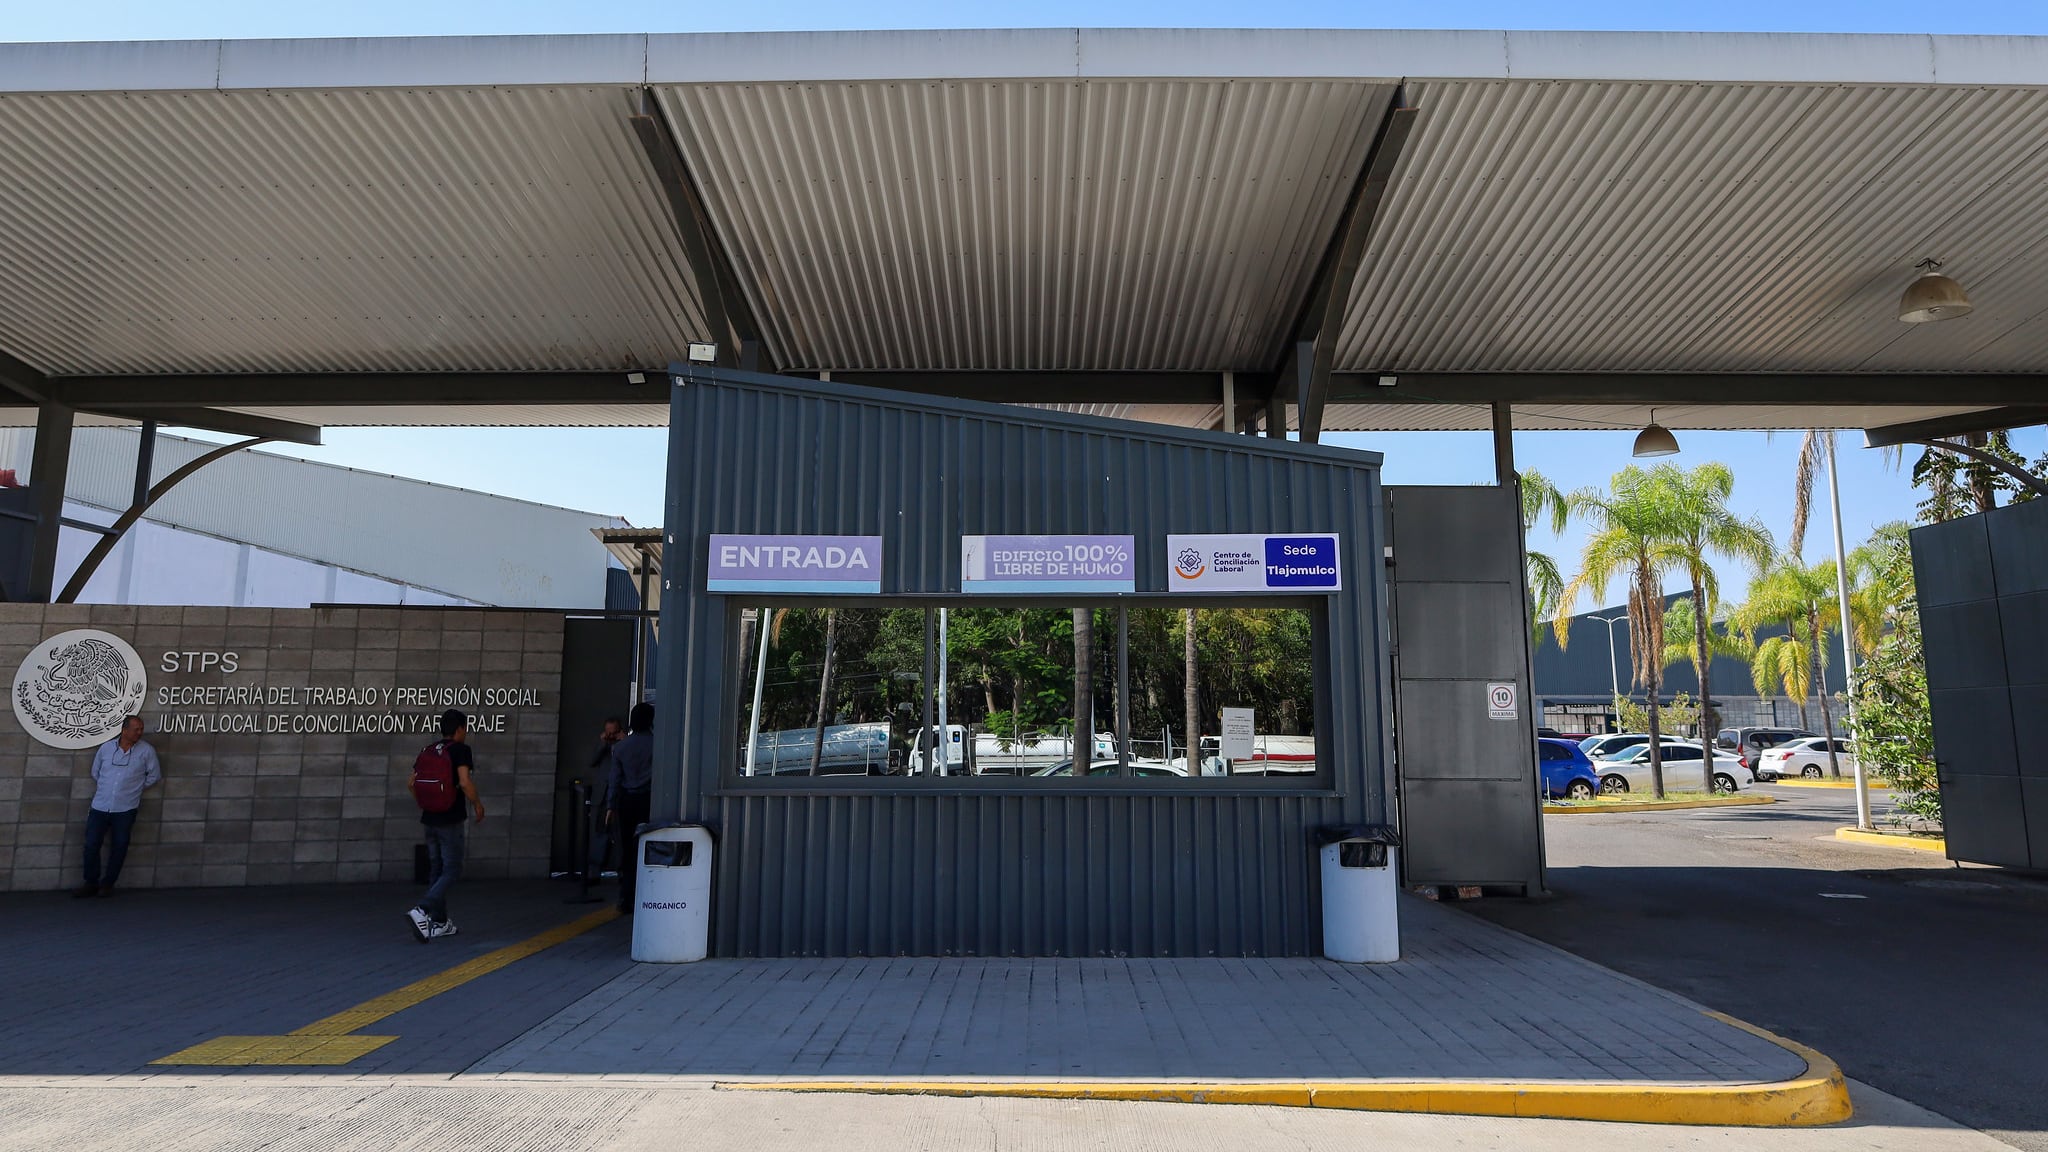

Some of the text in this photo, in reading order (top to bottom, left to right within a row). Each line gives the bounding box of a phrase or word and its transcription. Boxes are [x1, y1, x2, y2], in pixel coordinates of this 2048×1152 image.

[993, 545, 1128, 562] EDIFICIO 100%
[1213, 551, 1252, 559] Centro de
[1283, 544, 1317, 556] Sede
[720, 545, 869, 569] ENTRADA
[1213, 558, 1260, 566] Conciliación
[994, 562, 1124, 576] LIBRE DE HUMO
[1214, 565, 1244, 573] Laboral
[1267, 565, 1335, 578] Tlajomulco
[160, 651, 240, 674] STPS
[157, 682, 542, 707] SECRETARÍA DEL TRABAJO Y PREVISIÓN SOCIAL
[1495, 691, 1509, 702] 10
[156, 713, 207, 734] JUNTA
[210, 713, 263, 734] LOCAL
[266, 713, 290, 734] DE
[292, 710, 406, 734] CONCILIACIÓN
[408, 714, 420, 734] Y
